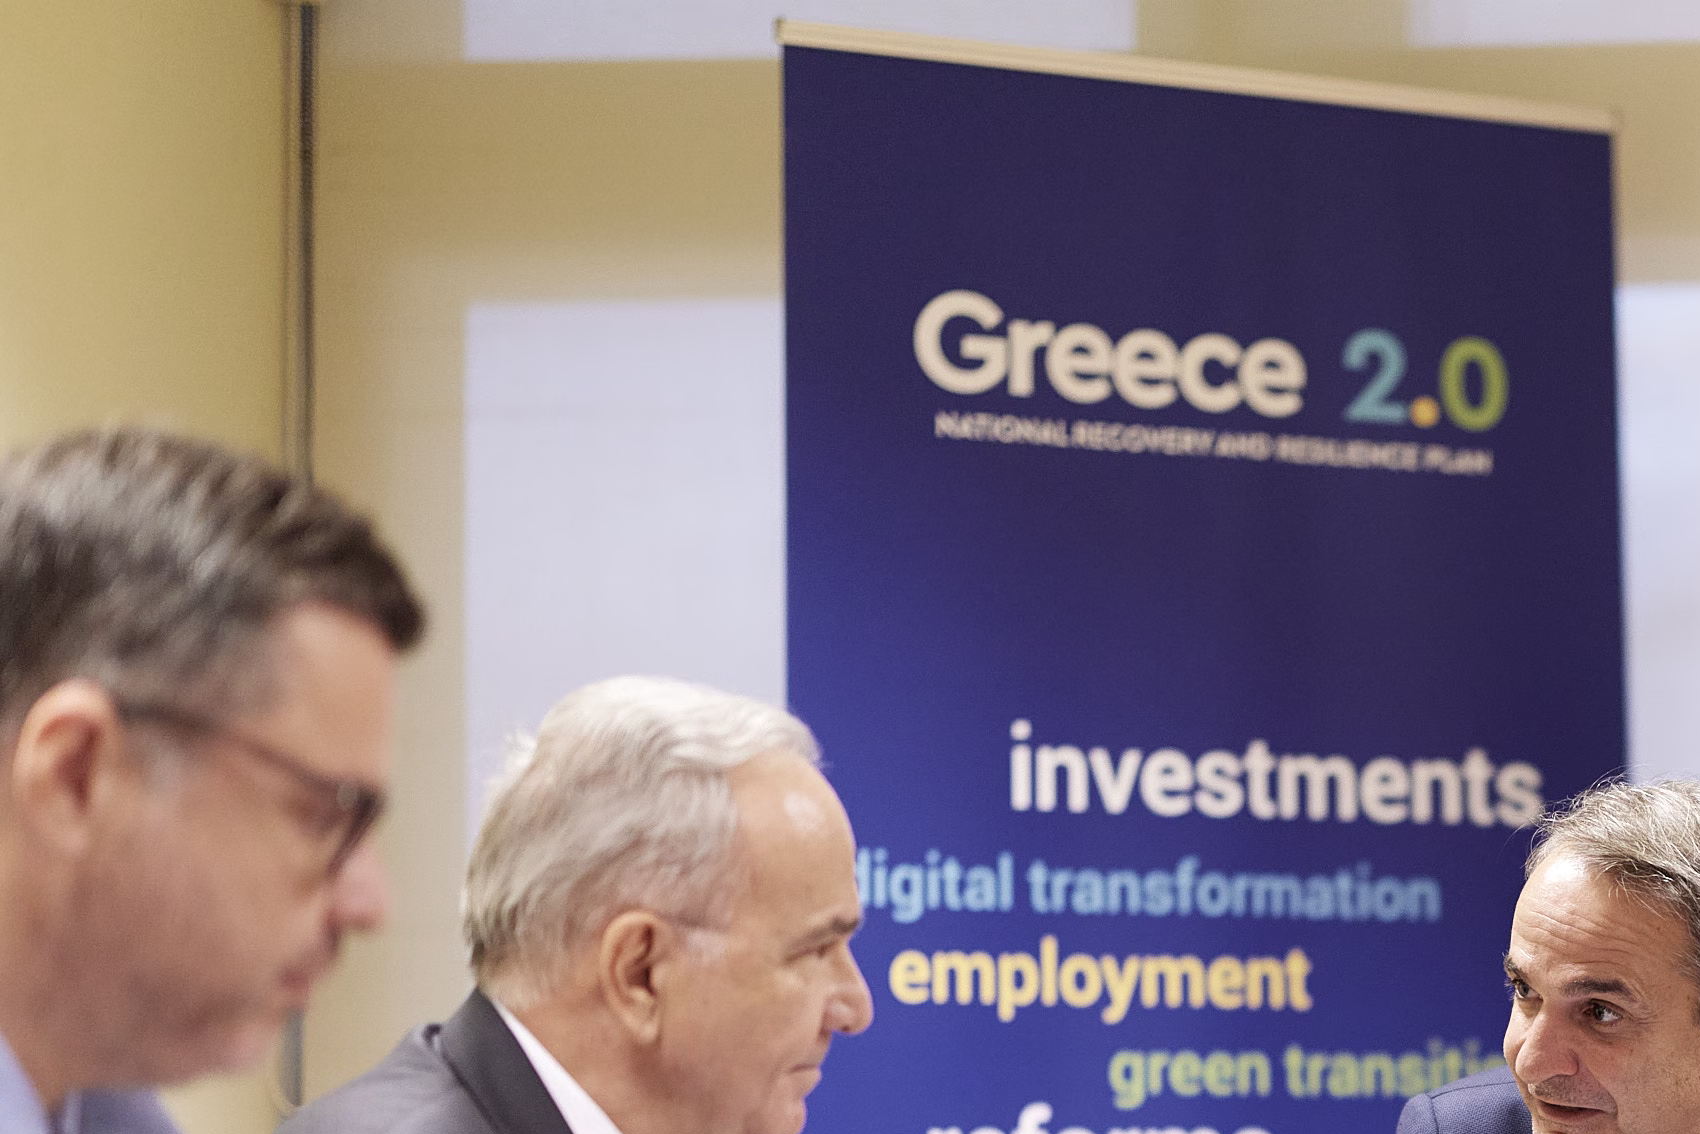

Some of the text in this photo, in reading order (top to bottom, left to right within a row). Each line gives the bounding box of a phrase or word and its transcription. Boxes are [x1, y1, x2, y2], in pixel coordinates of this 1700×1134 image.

[912, 289, 1508, 432] Greece 2.0
[934, 411, 1067, 448] NATIONAL
[1070, 420, 1215, 456] RECOVERY
[1214, 432, 1272, 461] AND
[1421, 444, 1494, 476] PLAN
[1009, 718, 1544, 829] investments
[1025, 856, 1443, 923] transformation
[888, 934, 1314, 1024] employment
[1108, 1046, 1271, 1110] green
